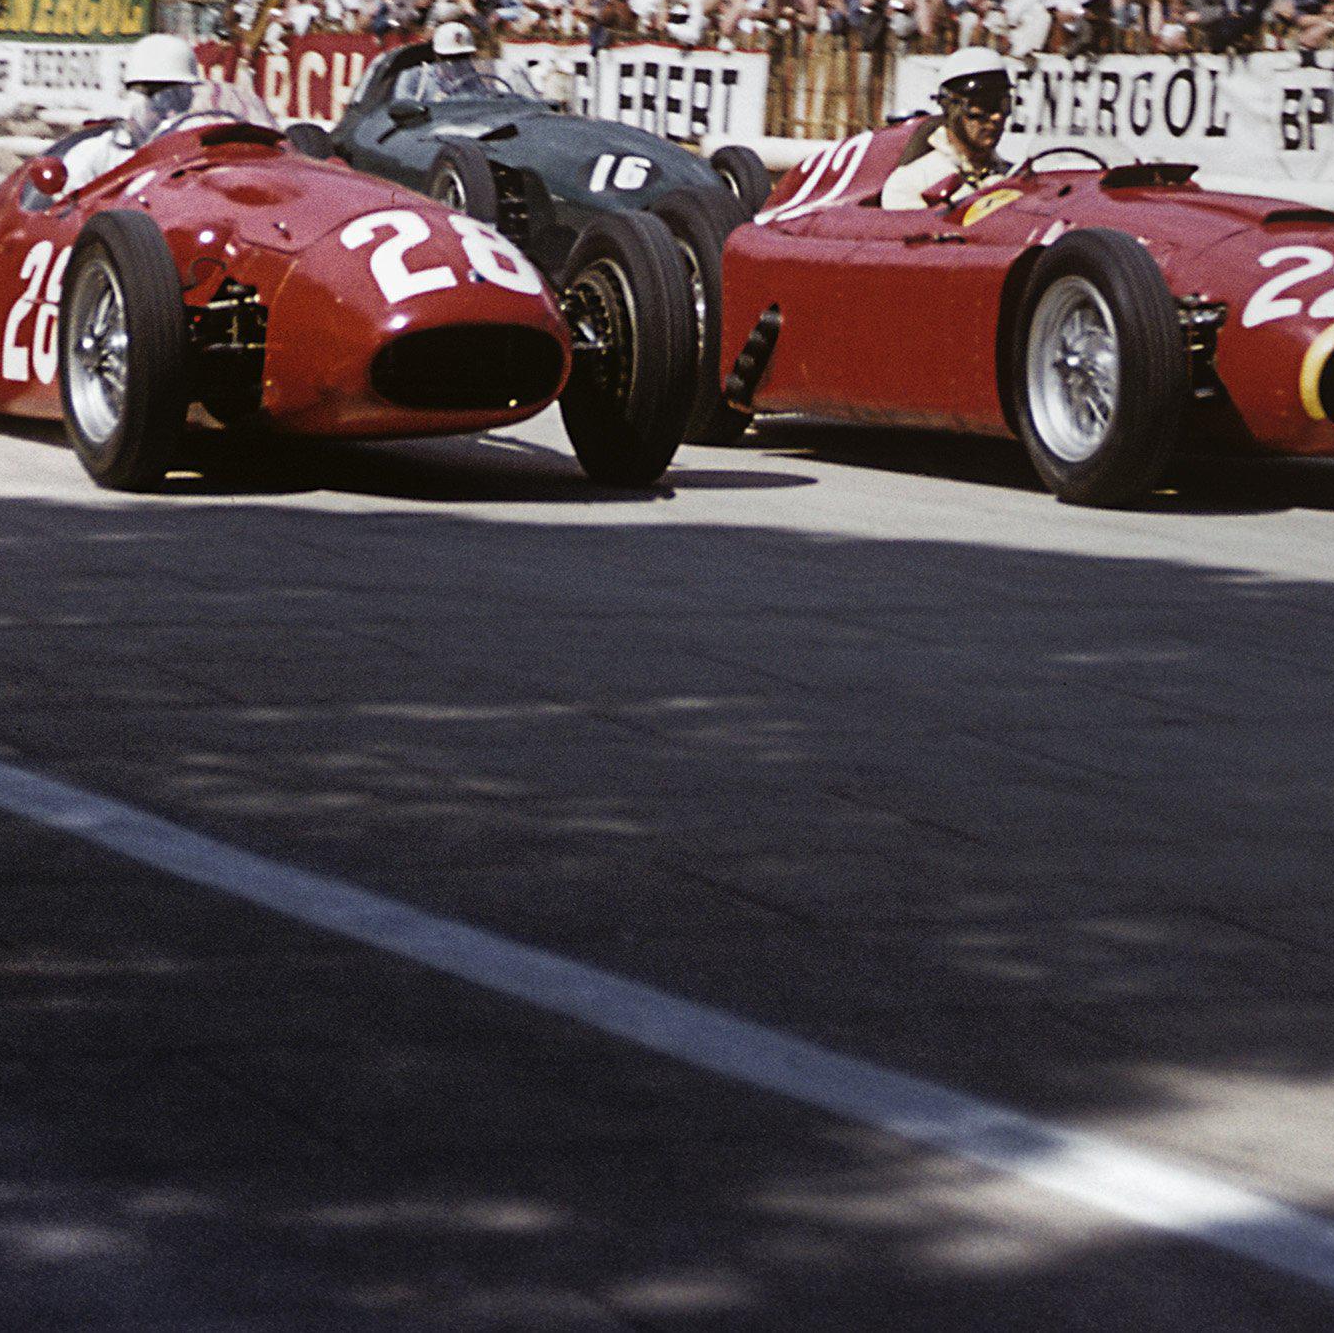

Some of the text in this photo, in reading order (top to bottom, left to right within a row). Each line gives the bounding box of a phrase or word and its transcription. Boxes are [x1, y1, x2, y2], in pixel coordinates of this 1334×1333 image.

[1010, 69, 1231, 137] ENERGOL
[589, 153, 652, 193] 16
[340, 209, 543, 304] 28
